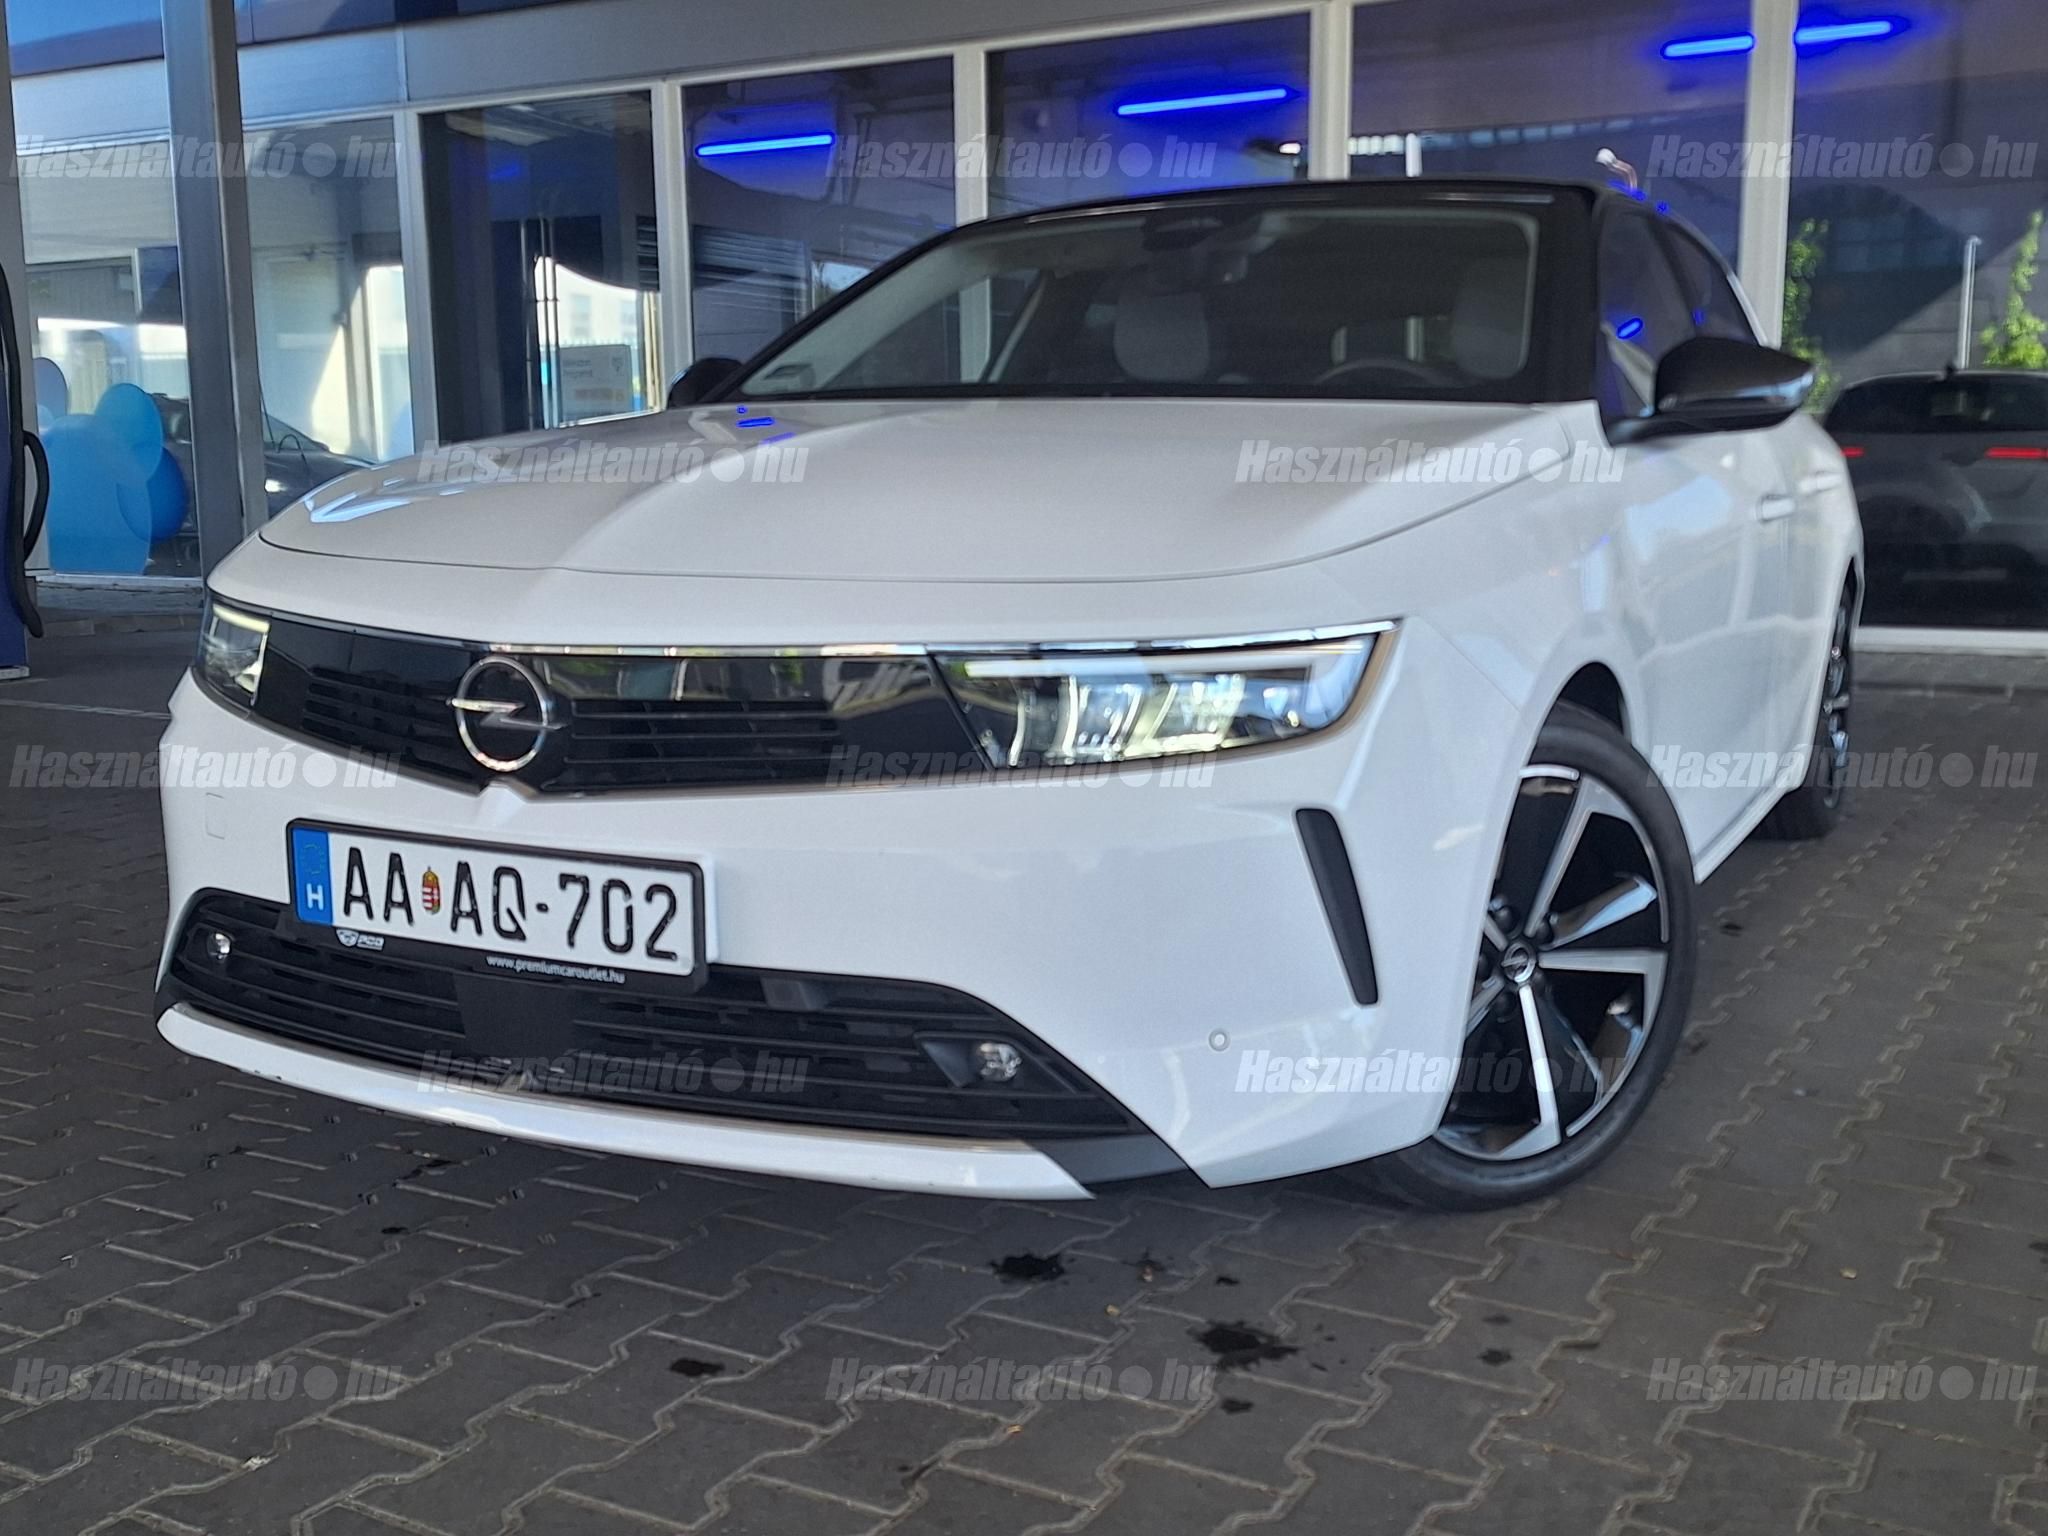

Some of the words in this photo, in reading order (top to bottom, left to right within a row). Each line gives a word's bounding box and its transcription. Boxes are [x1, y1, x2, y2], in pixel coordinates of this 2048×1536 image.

[307, 884, 324, 910] H
[343, 846, 414, 926] AA
[450, 860, 677, 961] AQ-702
[485, 955, 626, 984] www.premiumcaroutlet.hu
